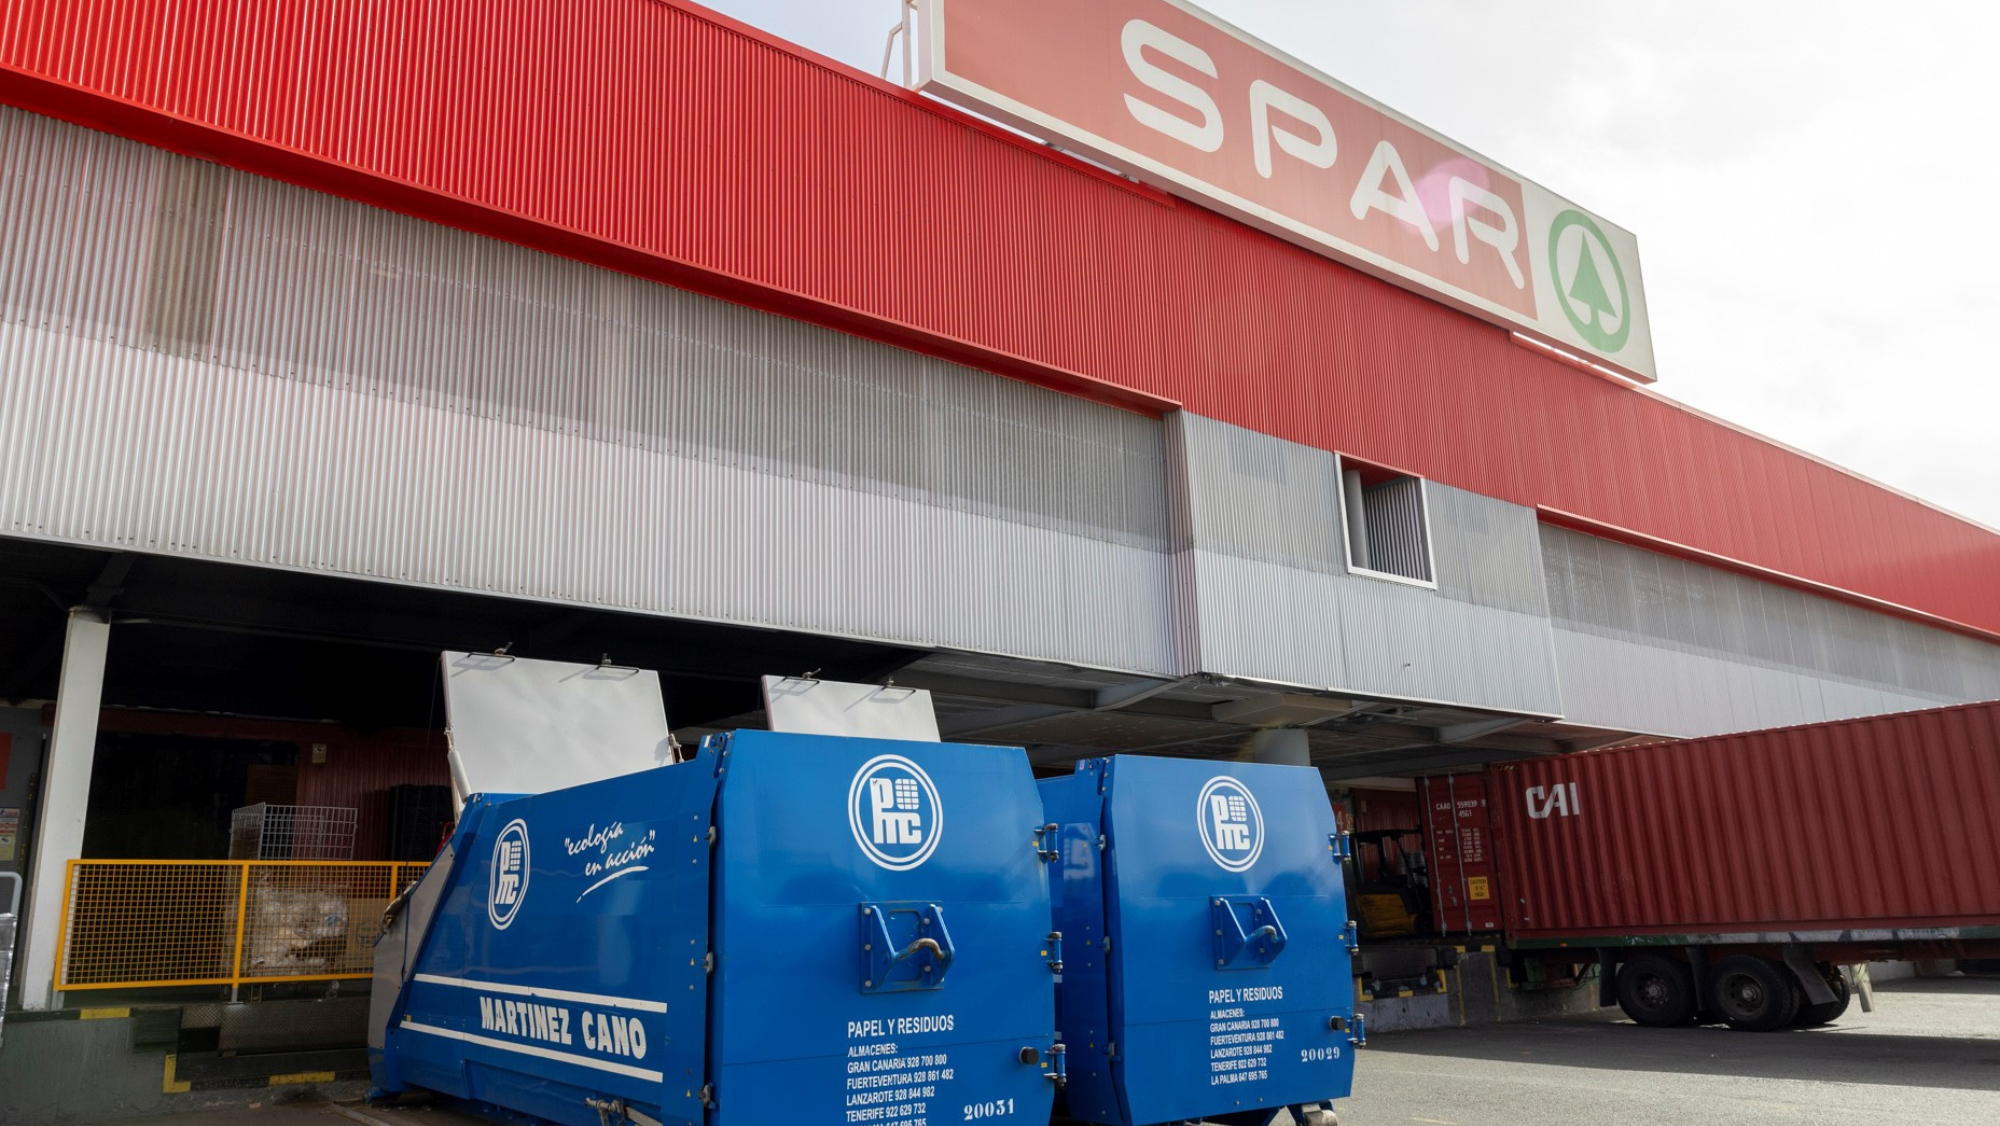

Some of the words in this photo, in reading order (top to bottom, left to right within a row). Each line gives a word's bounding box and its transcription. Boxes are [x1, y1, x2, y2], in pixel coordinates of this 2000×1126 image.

[1121, 18, 1525, 290] SPAR
[1526, 782, 1580, 819] CAI
[584, 860, 603, 877] en
[1209, 990, 1235, 1004] PAPEL
[1236, 988, 1242, 1002] Y
[1243, 986, 1283, 1001] RESIDUOS
[1210, 1008, 1245, 1019] ALMACENES:
[480, 996, 572, 1045] MARTINEZ
[581, 1010, 647, 1060] CANO
[848, 1021, 885, 1038] PAPEL
[888, 1019, 895, 1035] Y
[898, 1015, 954, 1034] RESIDUOS
[1210, 1022, 1226, 1033] GRAN
[1227, 1020, 1250, 1031] CANARIA
[1251, 1020, 1260, 1029] 928
[1210, 1033, 1255, 1046] FUERTEVENTURA
[1256, 1032, 1266, 1041] 928
[848, 1043, 898, 1058] ALMACENES:
[1210, 1046, 1243, 1059] LANZAROTE
[1243, 1046, 1252, 1055] 928
[1253, 1045, 1262, 1054] 844
[1301, 1046, 1340, 1062] 20029
[847, 1061, 870, 1074] GRAN
[872, 1058, 906, 1072] CANARIA
[907, 1056, 920, 1068] 928
[921, 1055, 933, 1067] 700
[934, 1054, 947, 1065] 800
[1211, 1060, 1237, 1072] TENERIFE
[1238, 1059, 1247, 1069] 922
[1257, 1058, 1266, 1067] 732
[846, 1072, 913, 1090] FUERTEVENTURA
[914, 1071, 926, 1084] 928
[928, 1070, 940, 1081] 861
[941, 1068, 954, 1080] 482
[1211, 1076, 1219, 1085] LA
[1220, 1073, 1238, 1085] PALMA
[846, 1088, 894, 1106] LANZAROTE
[895, 1089, 907, 1101] 928
[908, 1087, 921, 1100] 844
[922, 1086, 935, 1097] 982
[846, 1107, 884, 1122] TENERIFE
[886, 1106, 898, 1118] 922
[900, 1104, 912, 1116] 629
[914, 1102, 926, 1114] 732
[964, 1098, 1015, 1121] 20031
